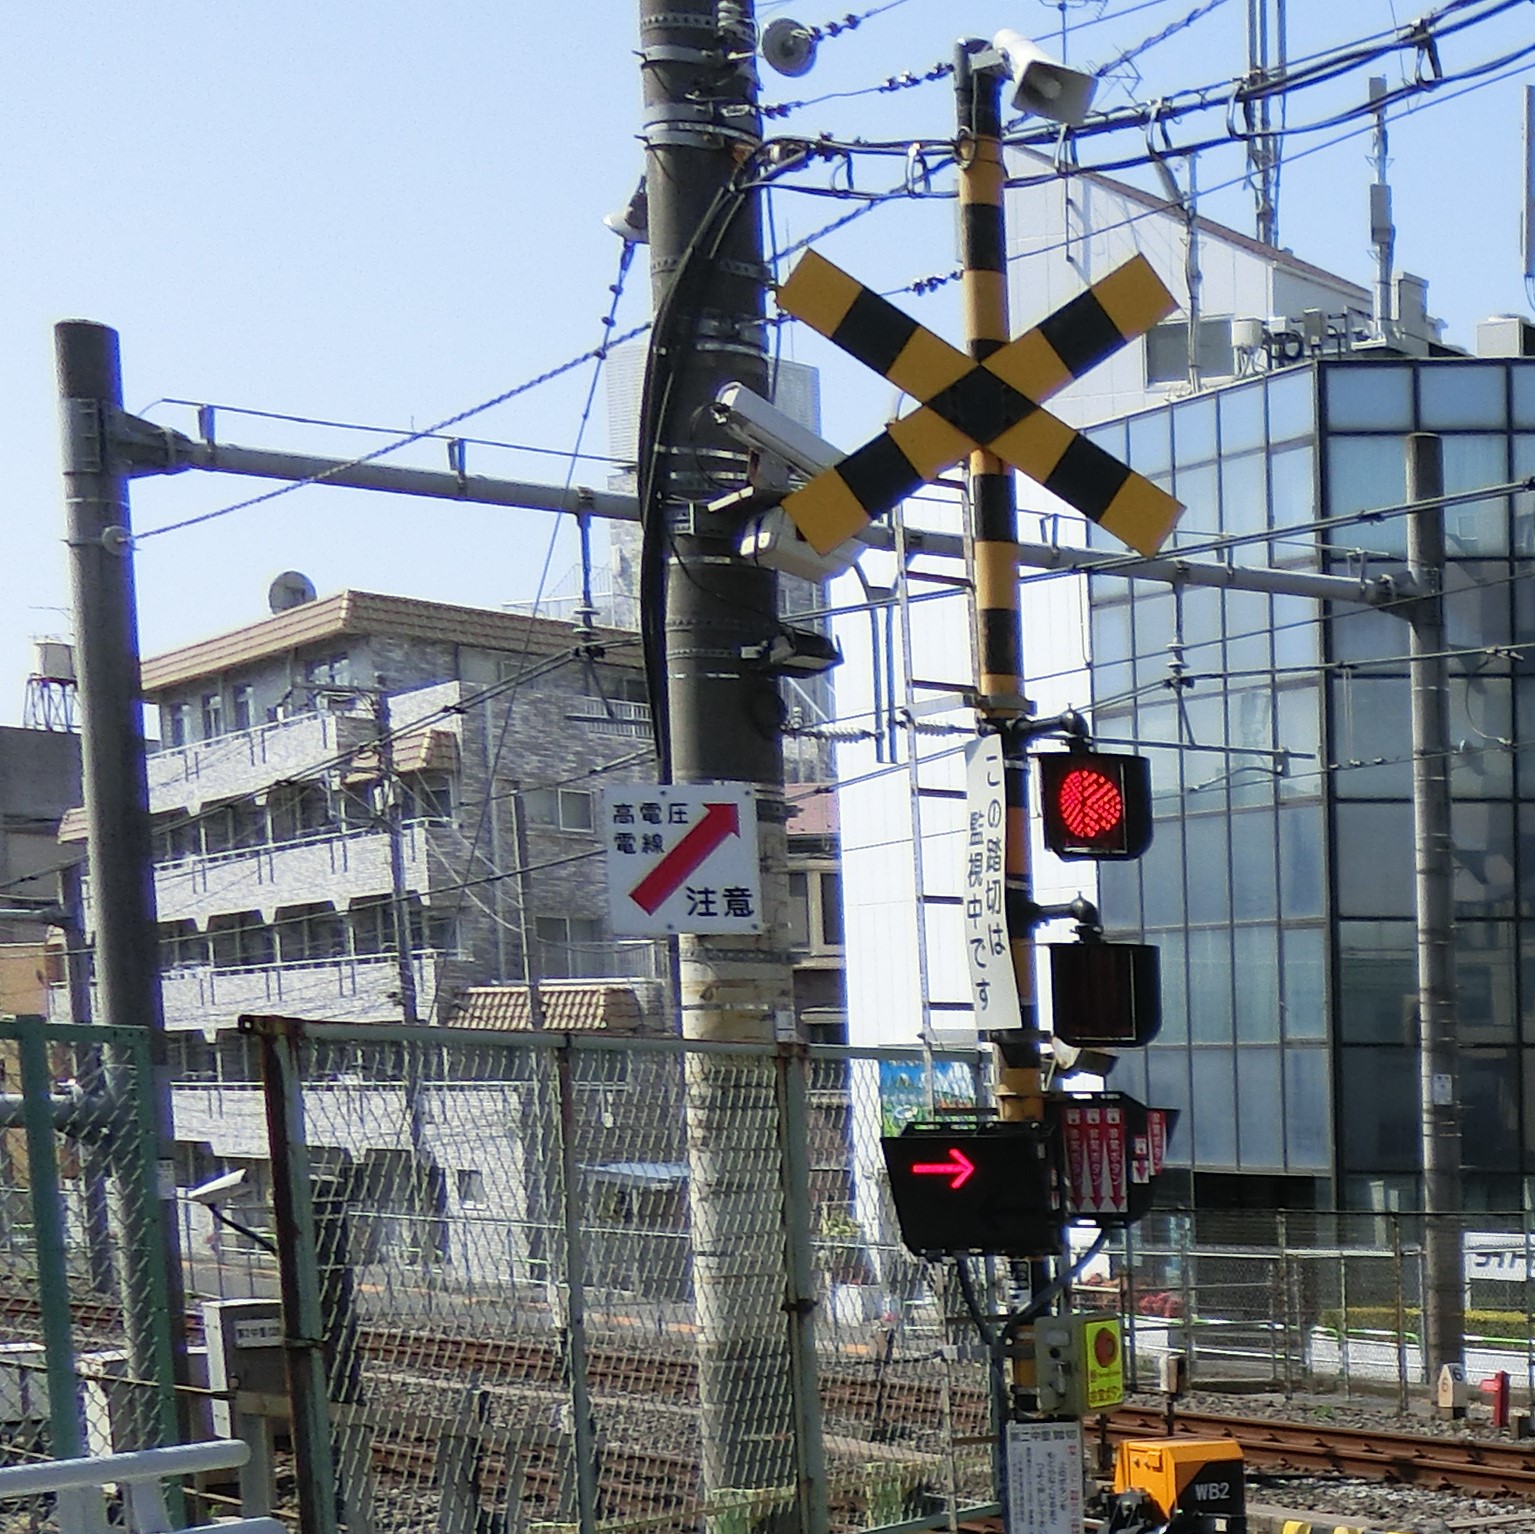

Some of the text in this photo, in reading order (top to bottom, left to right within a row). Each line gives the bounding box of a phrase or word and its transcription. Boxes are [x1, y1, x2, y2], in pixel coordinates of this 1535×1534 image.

[613, 802, 689, 825] 高電圧
[613, 832, 665, 855] 電線
[985, 755, 1006, 957] この踏切は
[686, 886, 755, 918] 注意
[966, 809, 992, 1011] 監視中です
[1452, 1366, 1463, 1382] 6
[1194, 1482, 1231, 1501] WB2
